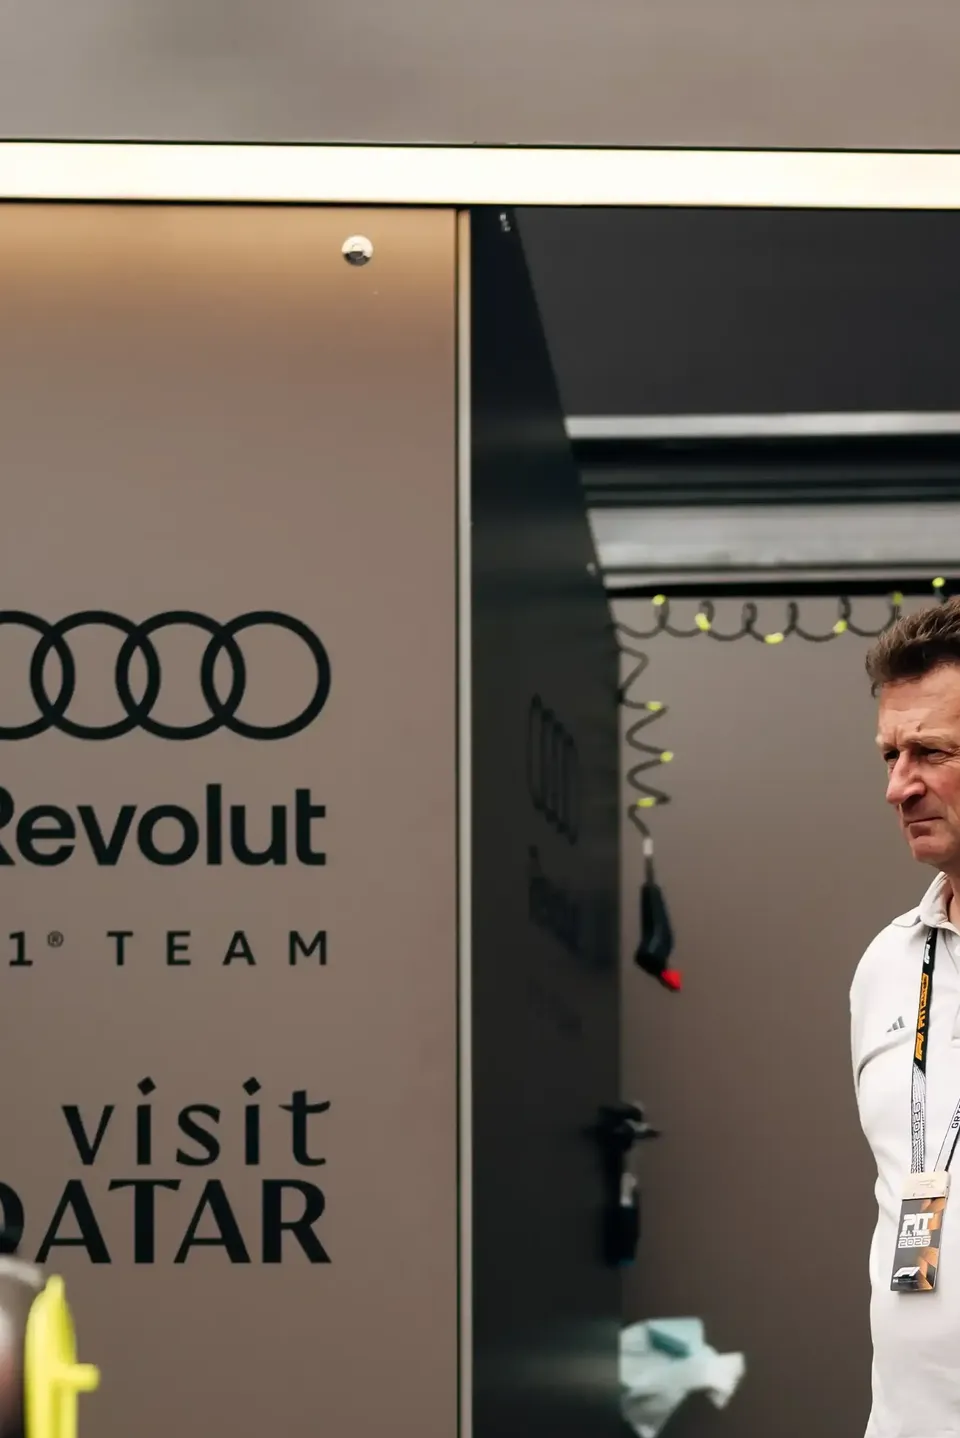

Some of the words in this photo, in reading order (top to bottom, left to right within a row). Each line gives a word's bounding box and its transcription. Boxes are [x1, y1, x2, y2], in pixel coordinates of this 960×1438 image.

[0, 783, 327, 866] evolut
[107, 932, 328, 966] TEAM
[61, 1076, 331, 1167] visit
[0, 1179, 332, 1265] ATAR
[898, 1236, 931, 1248] 2026
